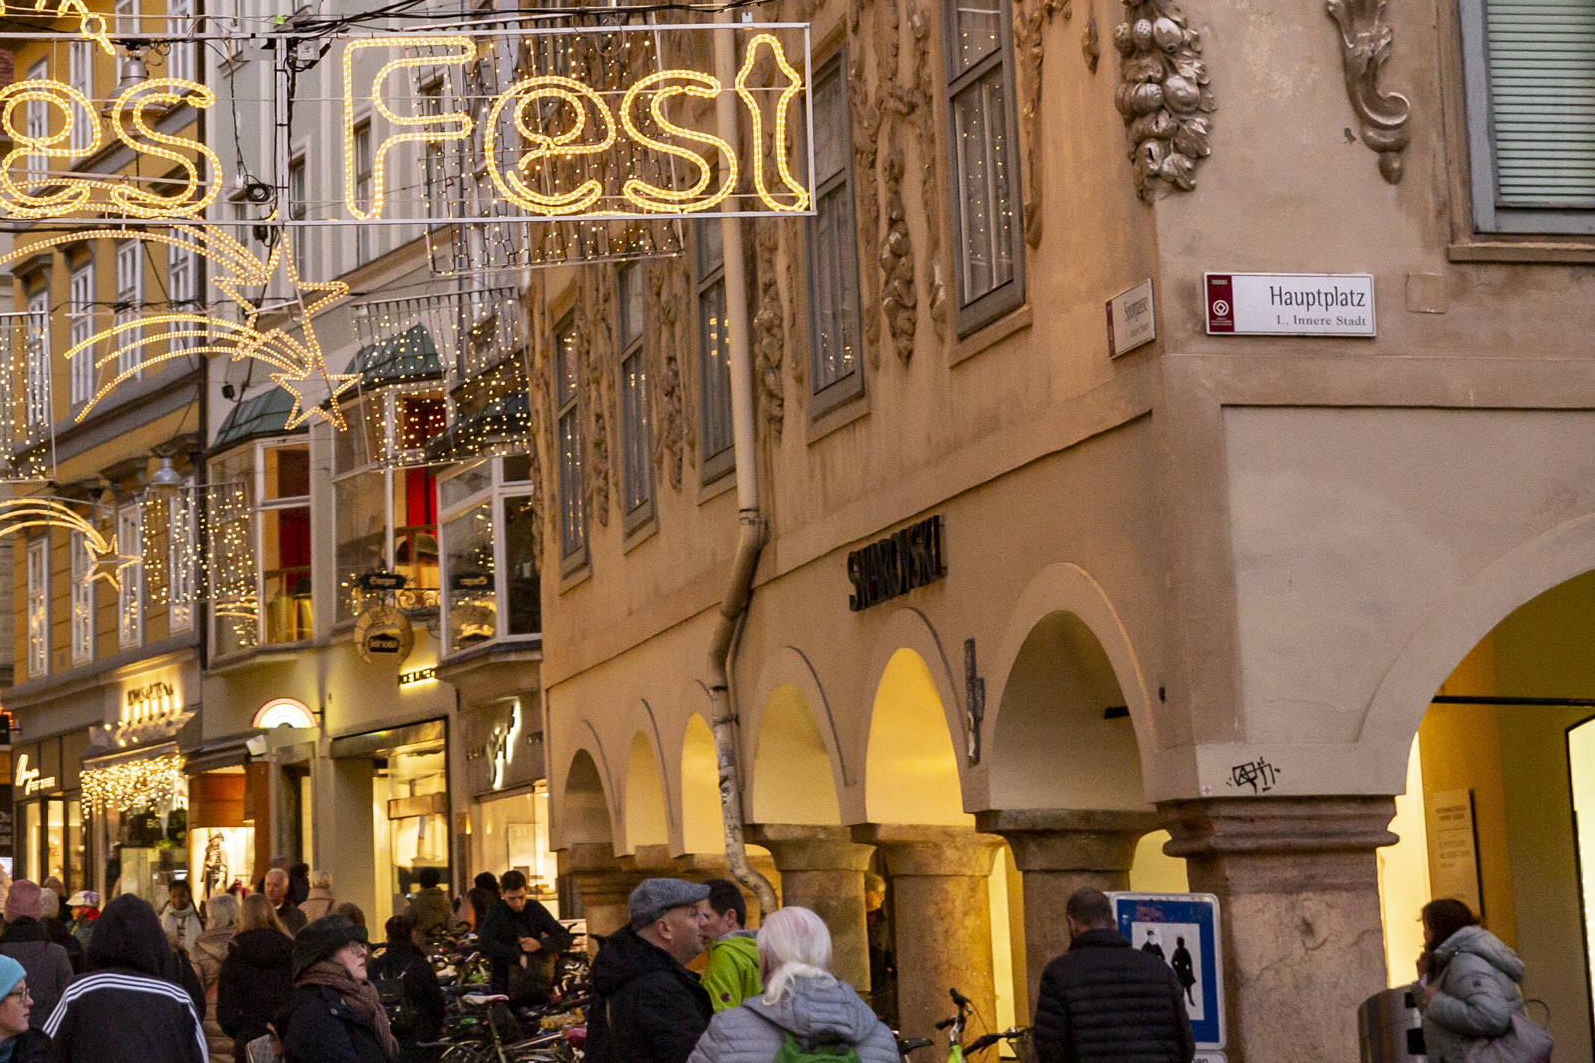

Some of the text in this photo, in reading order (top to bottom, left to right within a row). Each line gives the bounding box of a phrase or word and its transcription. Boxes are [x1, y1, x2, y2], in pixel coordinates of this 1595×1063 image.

[342, 33, 810, 221] Fest
[1270, 285, 1366, 312] Hauptplatz
[1293, 315, 1332, 327] Innere
[1336, 315, 1366, 327] Stadt
[847, 514, 943, 612] SWAROVSKI
